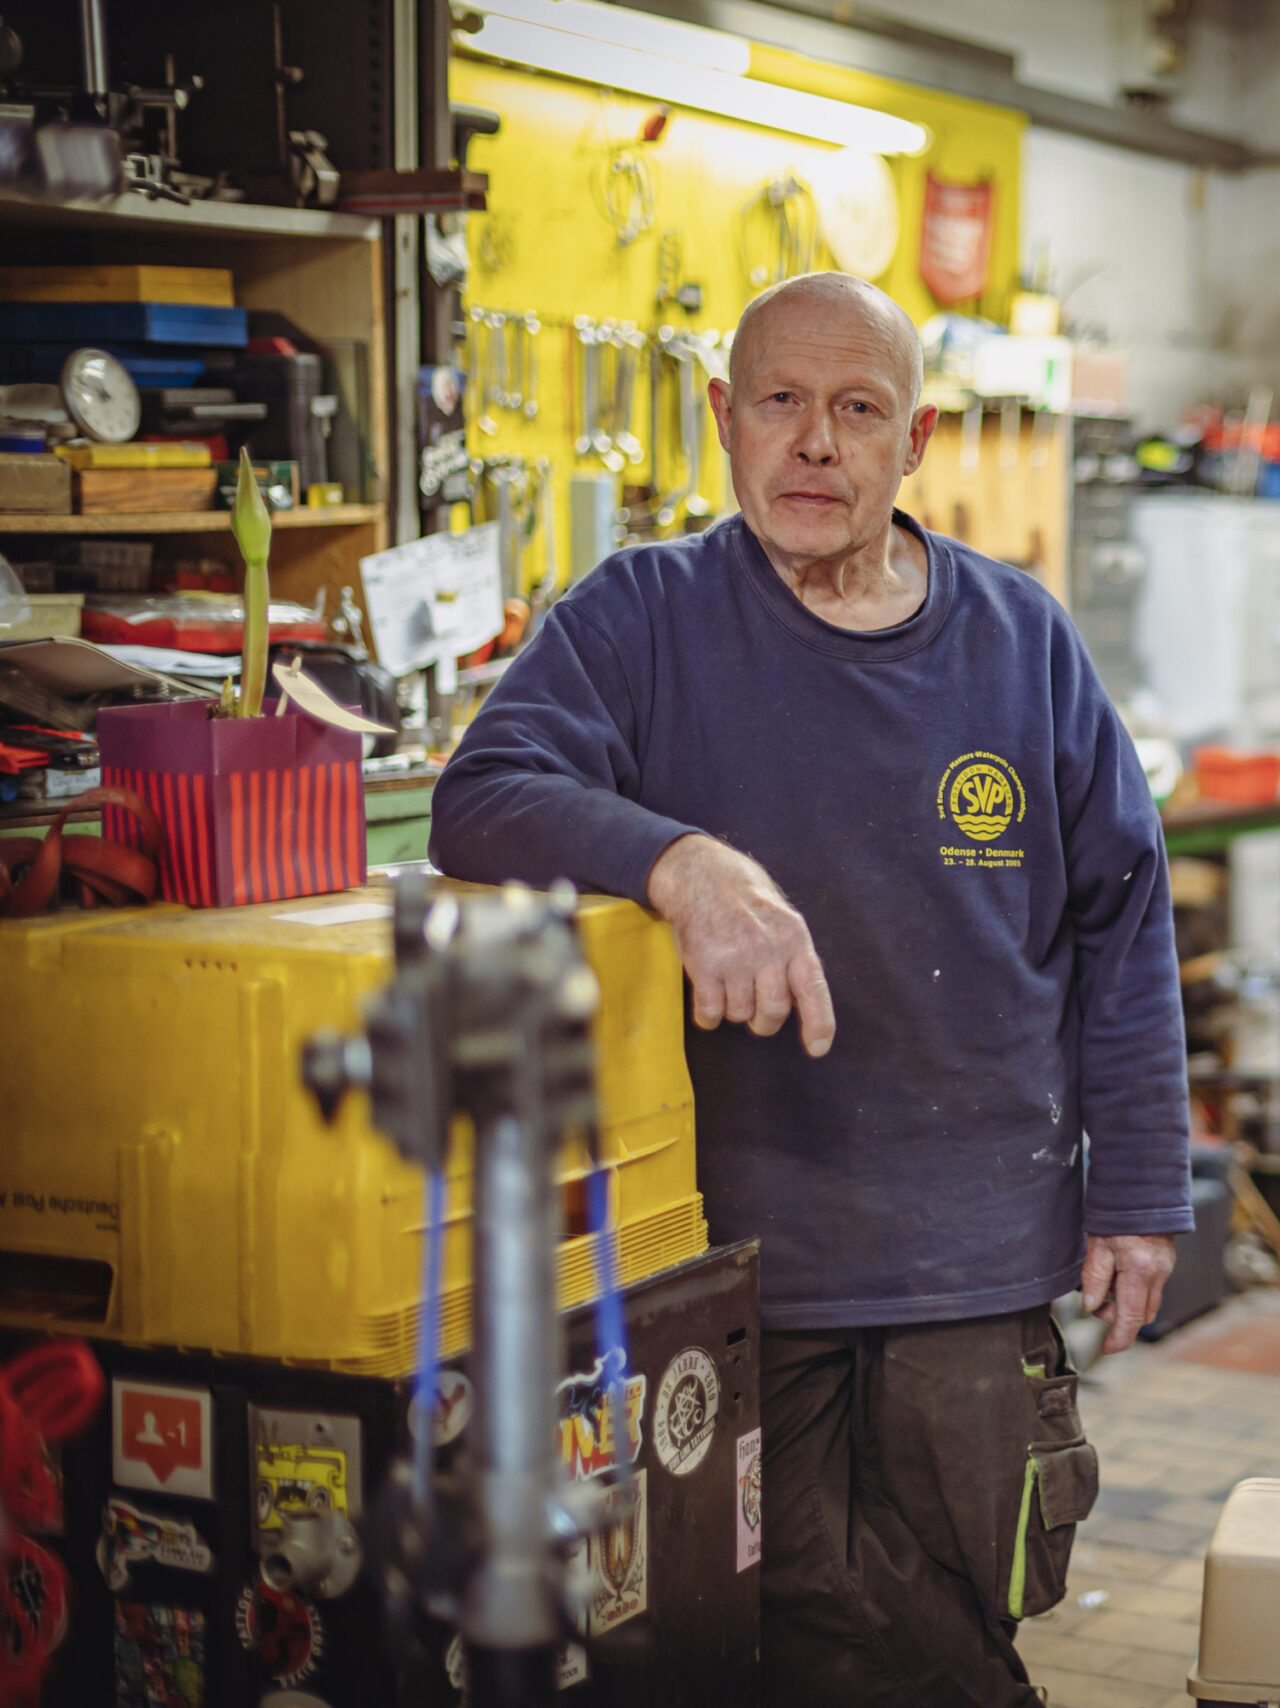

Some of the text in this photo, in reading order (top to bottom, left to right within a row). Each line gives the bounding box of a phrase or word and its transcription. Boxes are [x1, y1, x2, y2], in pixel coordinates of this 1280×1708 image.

[937, 768, 951, 804] European
[949, 752, 975, 770] Masters
[975, 750, 1008, 768] Waterpolo
[961, 775, 1005, 814] SVP
[940, 846, 1024, 858] Odense Denmark
[978, 859, 1004, 868] August
[13, 1193, 44, 1214] Post
[48, 1195, 120, 1219] Deutsche
